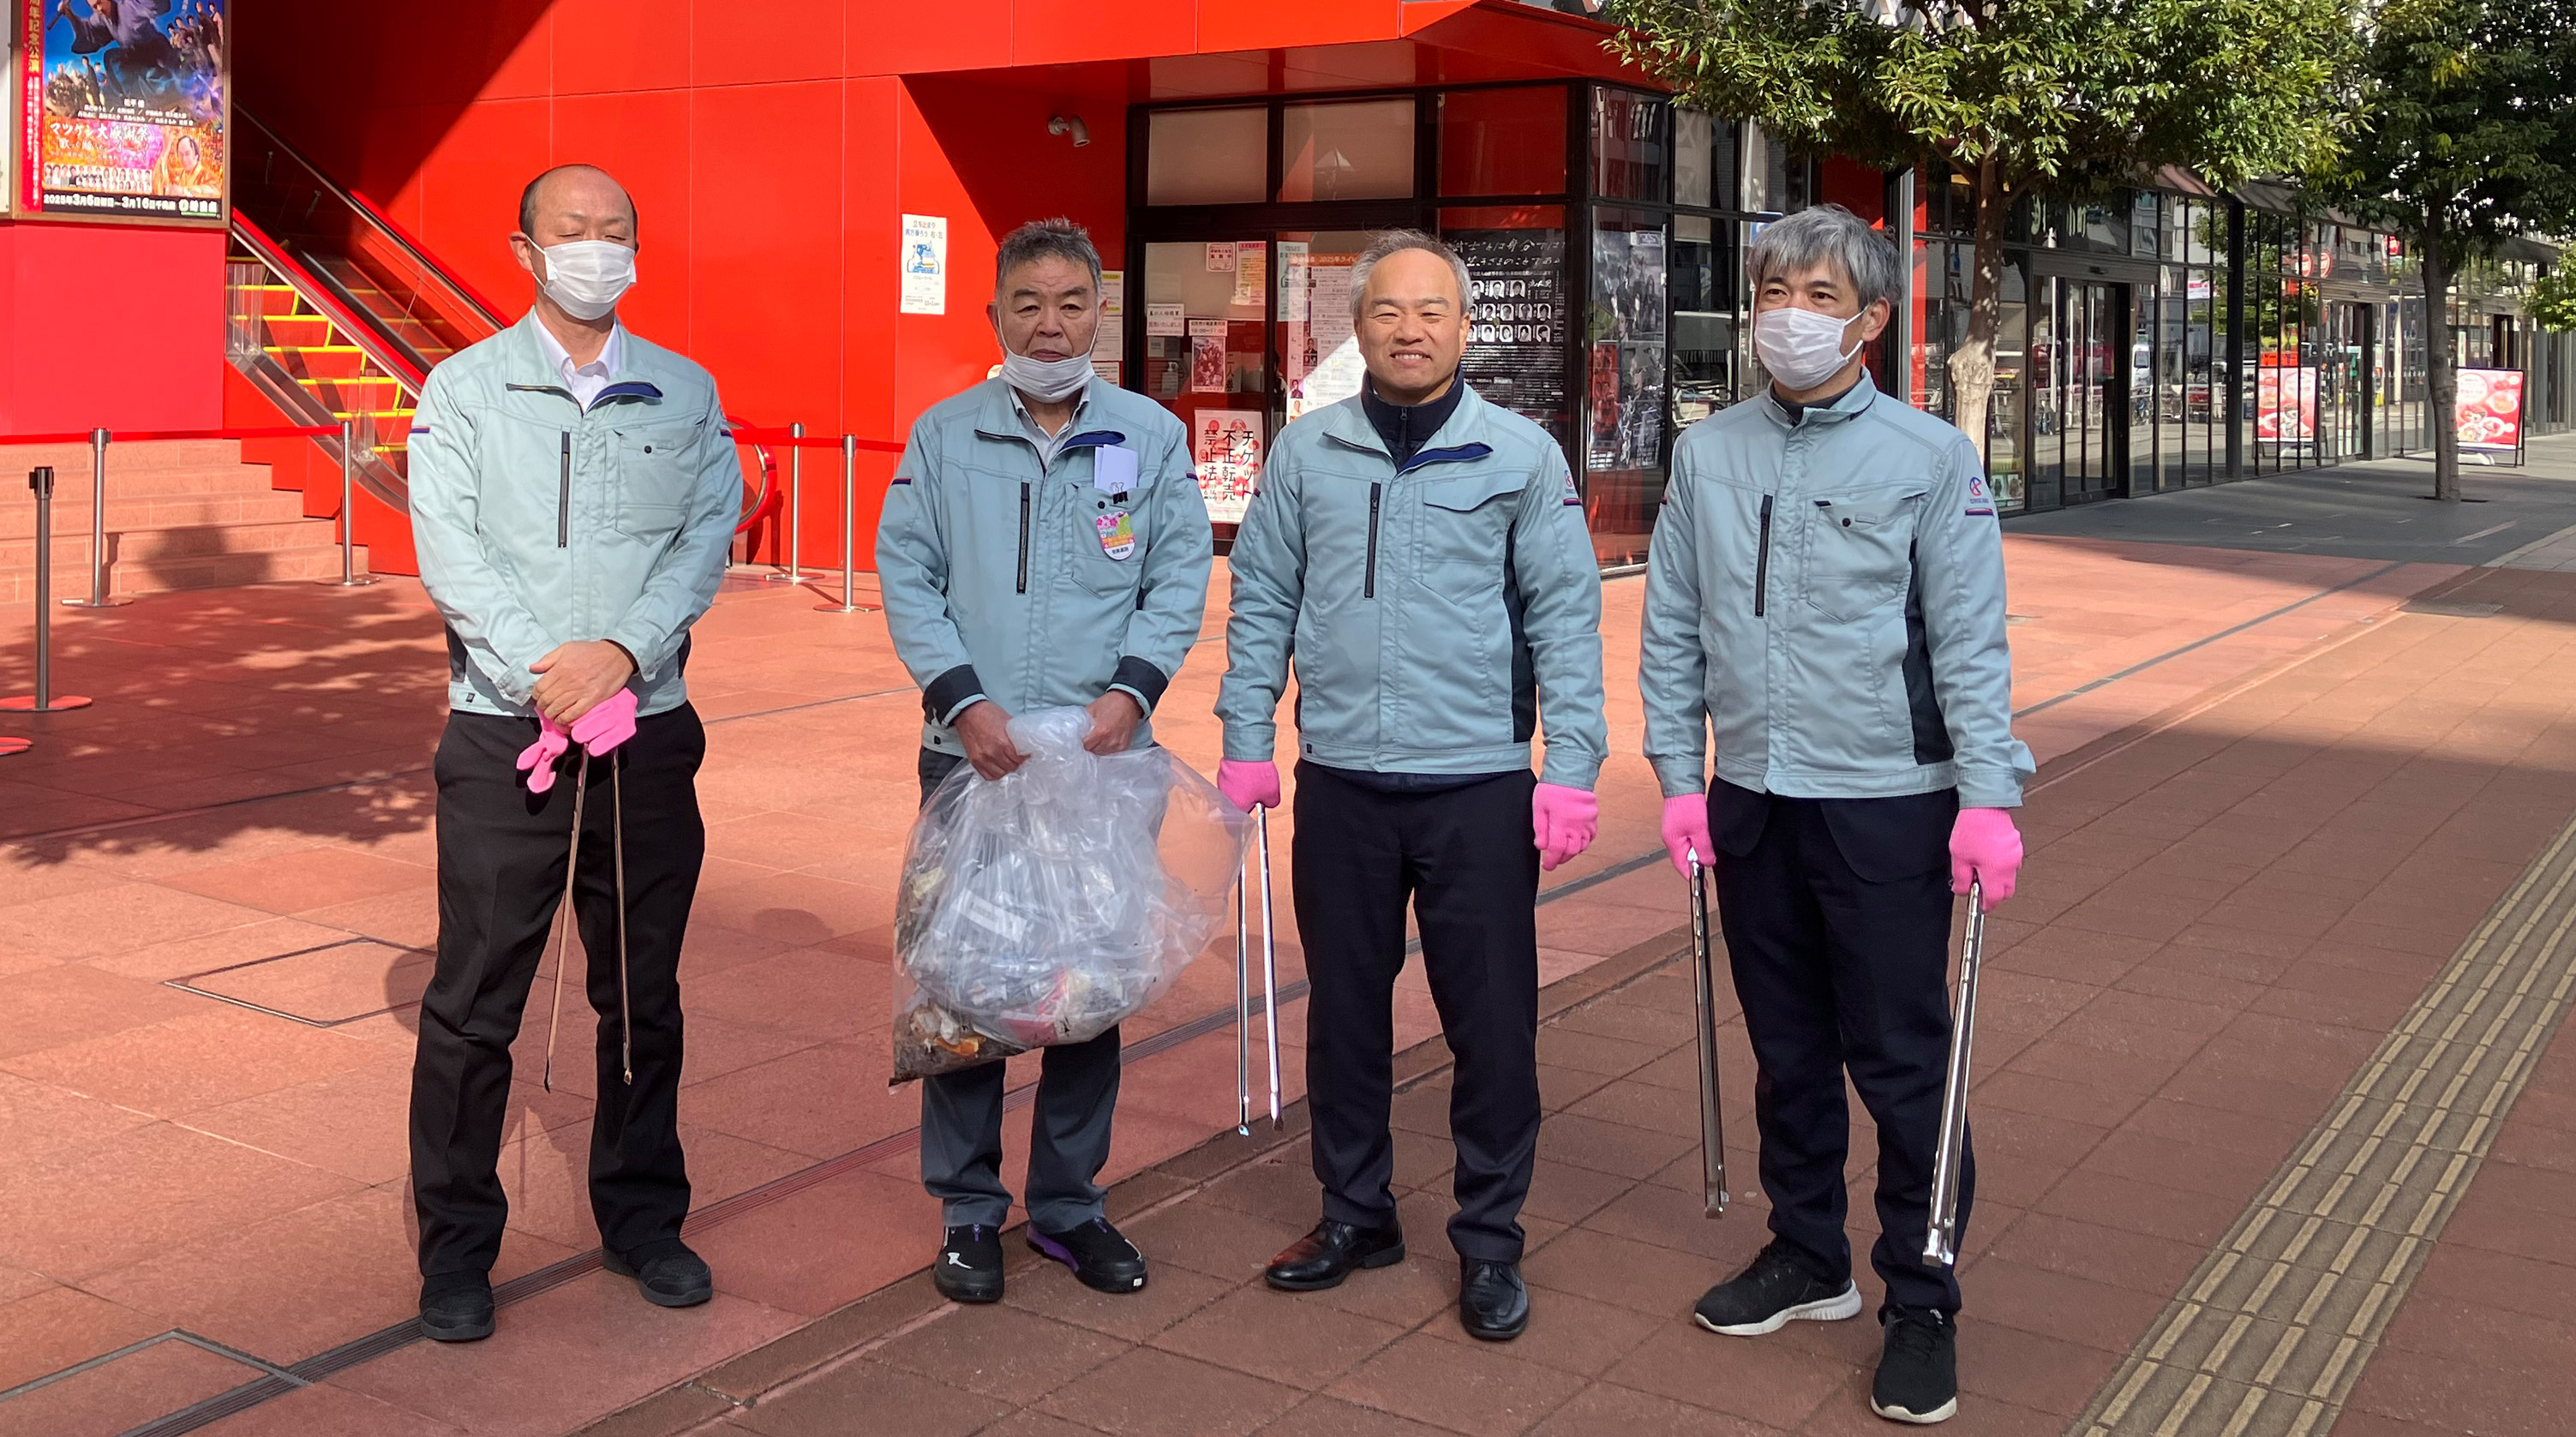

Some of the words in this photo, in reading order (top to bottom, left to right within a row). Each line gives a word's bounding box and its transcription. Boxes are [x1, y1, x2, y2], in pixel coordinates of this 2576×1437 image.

[1203, 428, 1218, 481] 禁止法
[1223, 429, 1237, 500] 不正転売
[1242, 430, 1254, 500] チケット
